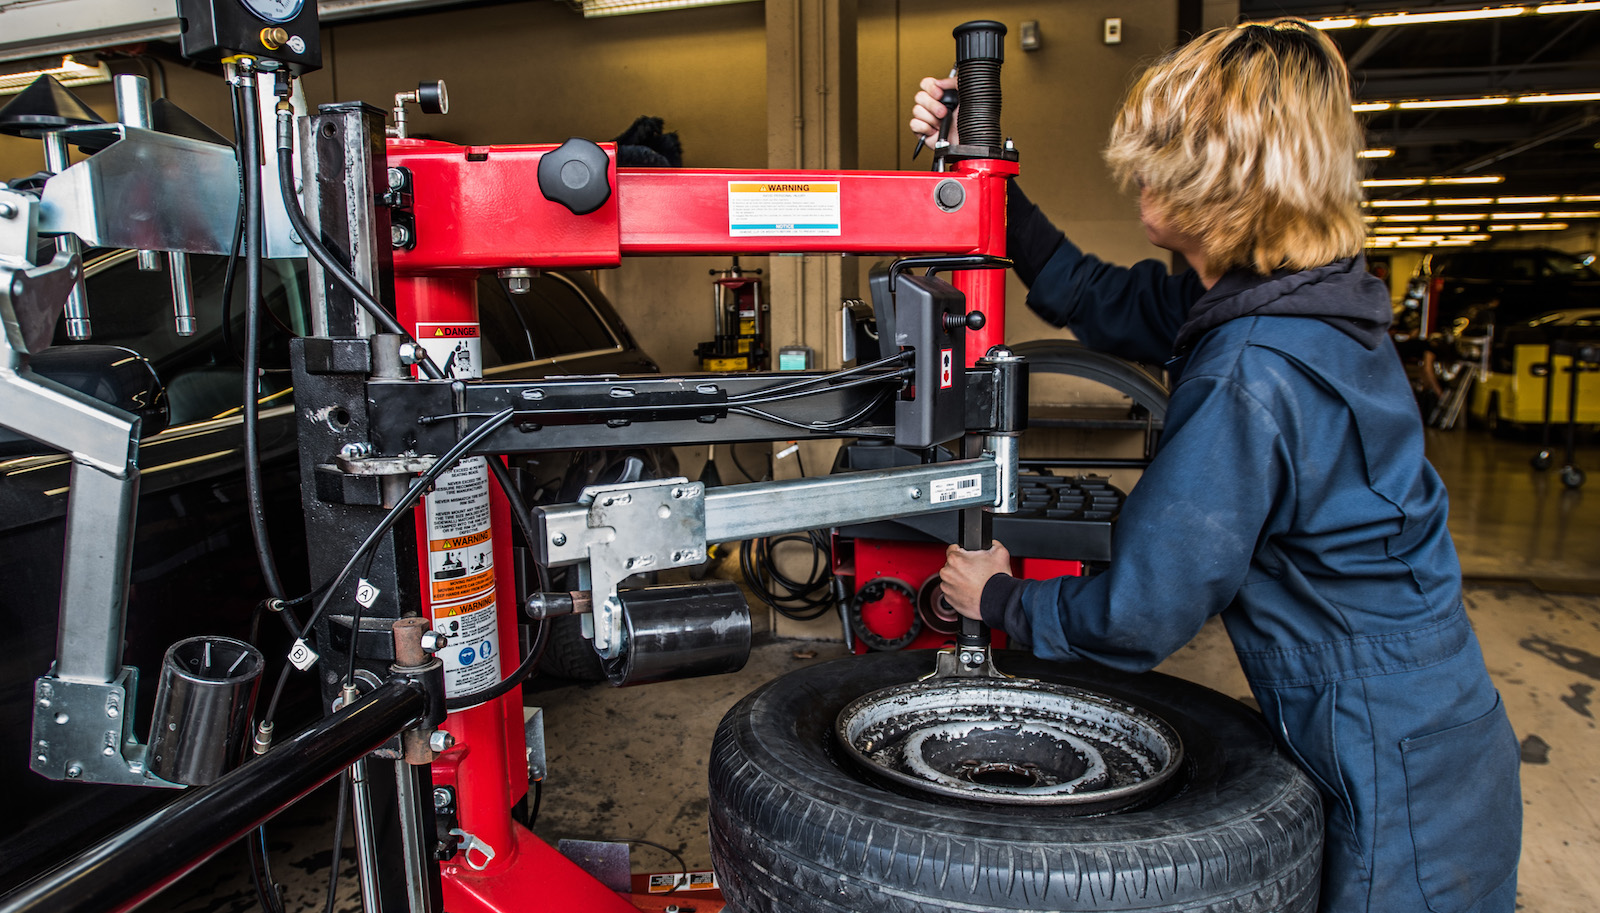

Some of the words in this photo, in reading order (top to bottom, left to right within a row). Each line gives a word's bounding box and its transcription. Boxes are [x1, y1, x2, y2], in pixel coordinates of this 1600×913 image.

[444, 327, 476, 336] DANGER
[452, 530, 488, 546] WARNING
[359, 589, 369, 600] A
[460, 596, 492, 613] WARNING
[293, 648, 304, 659] B
